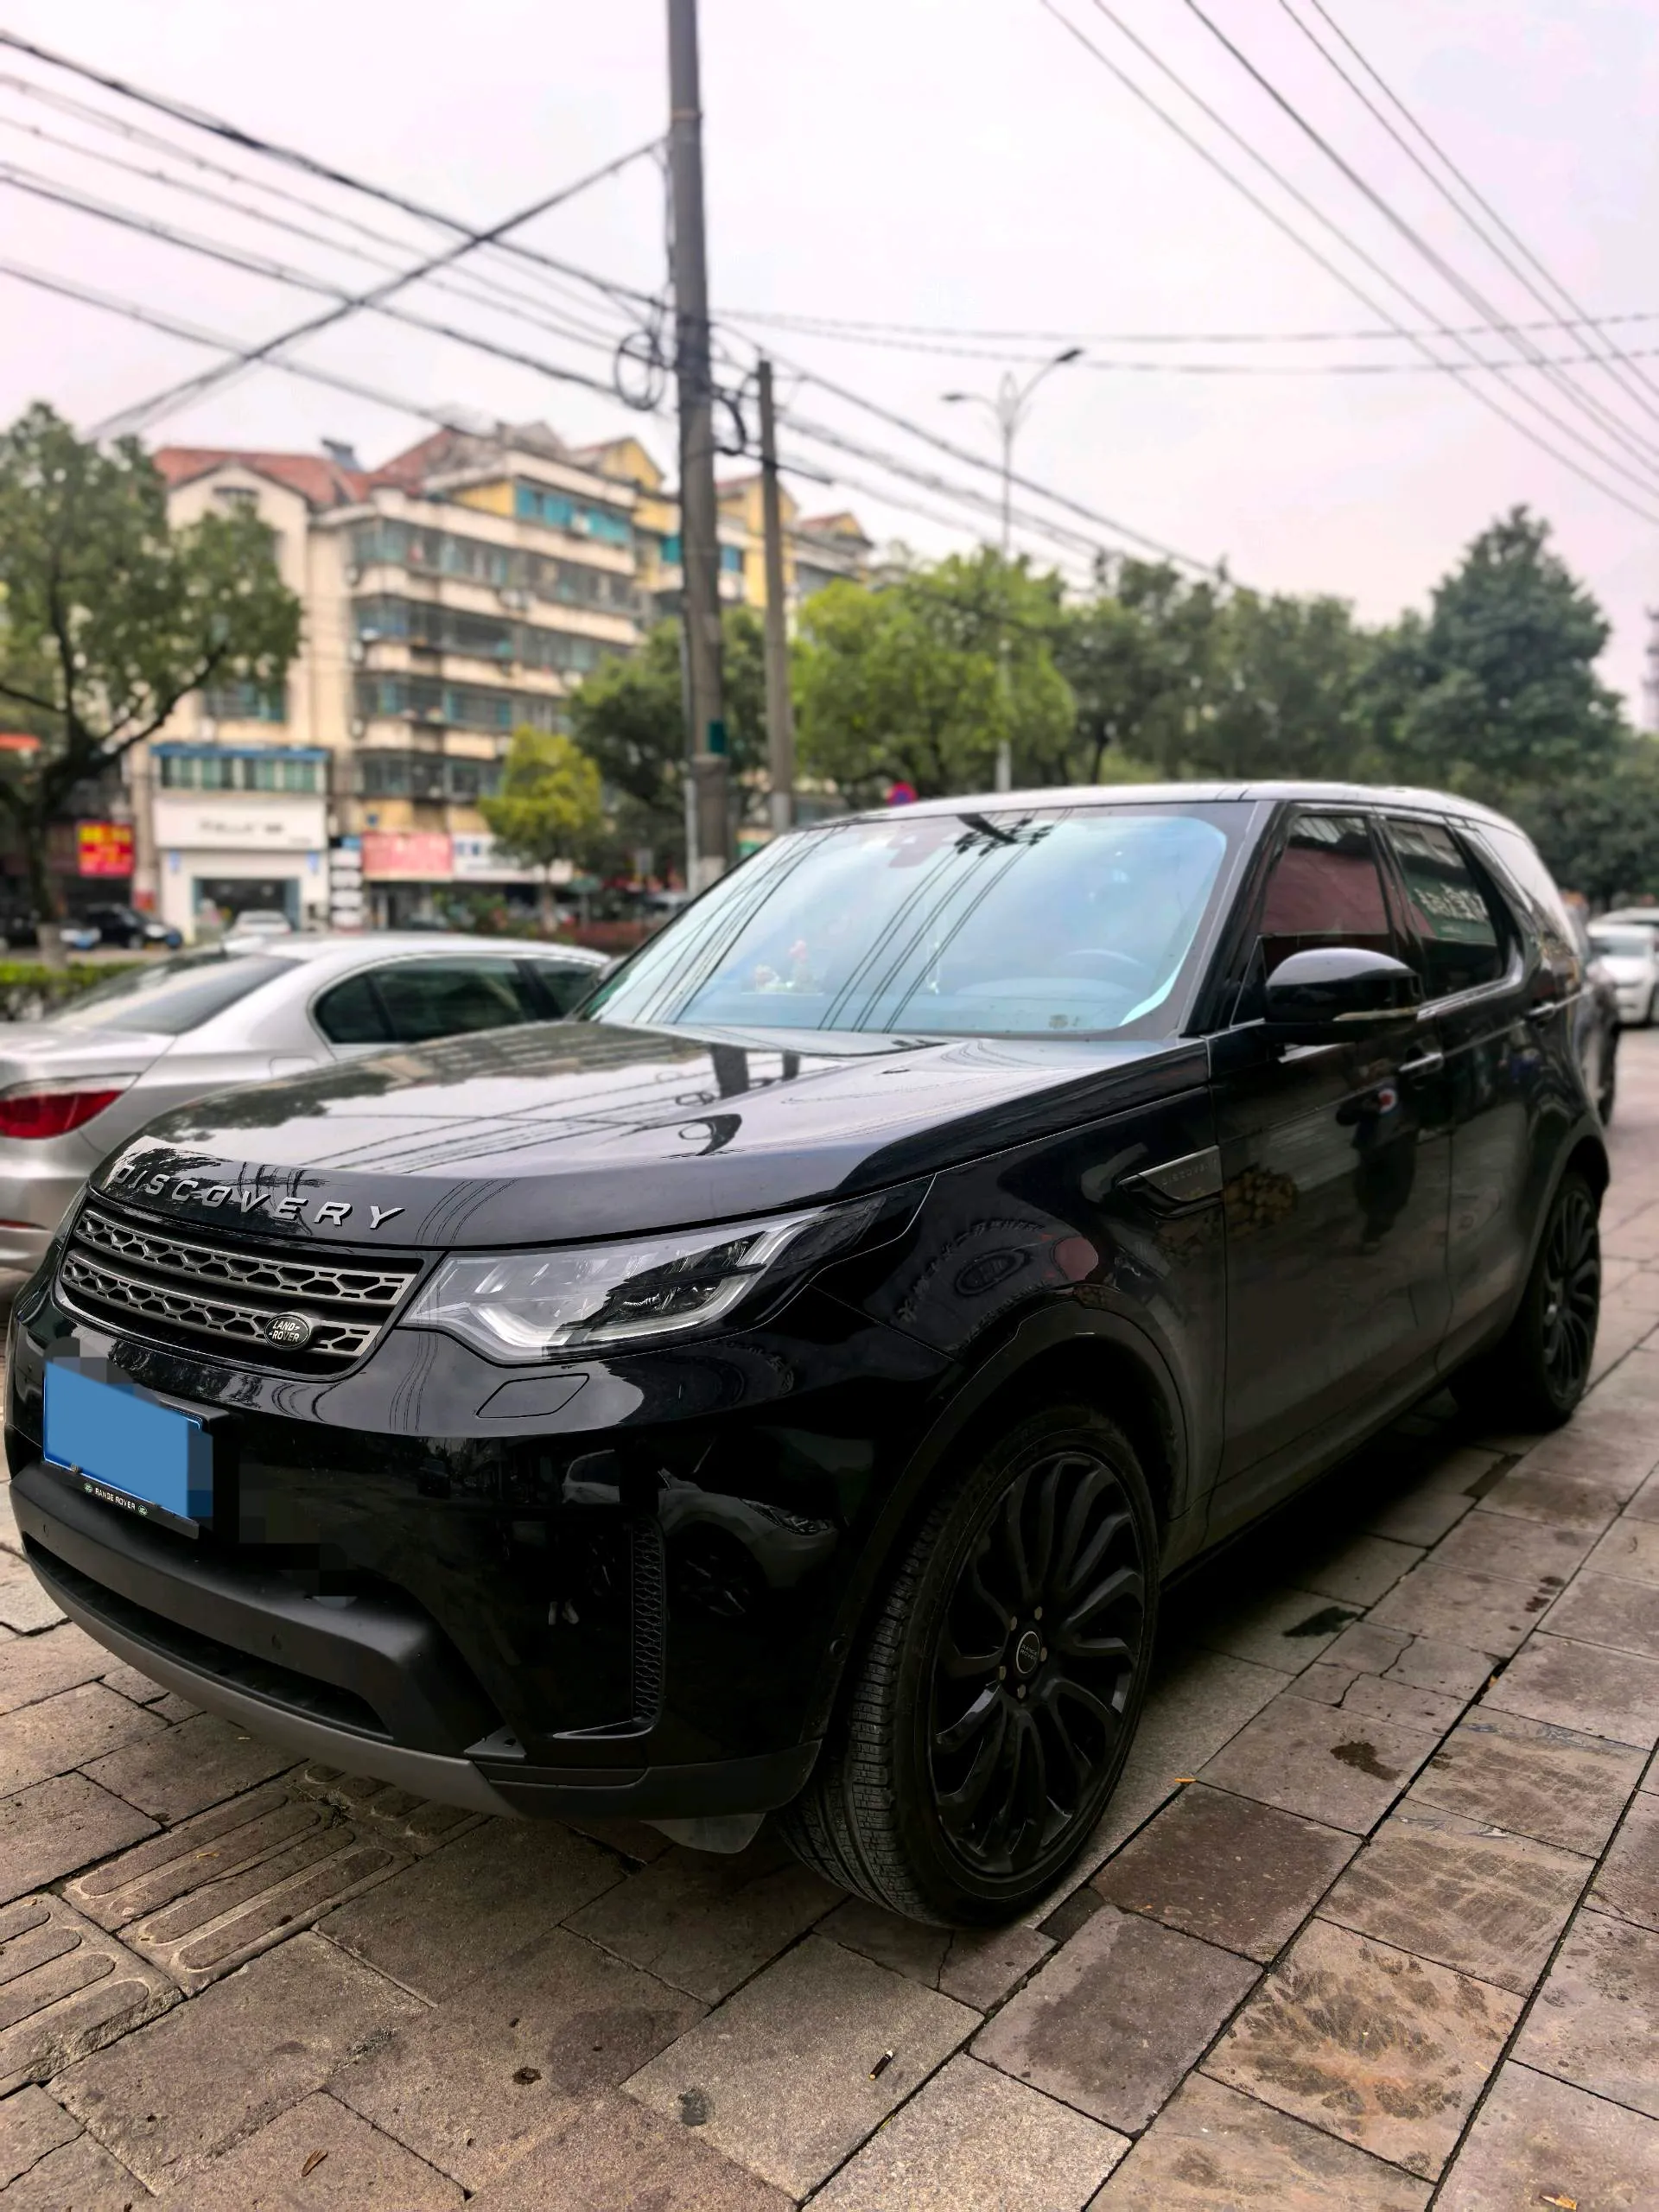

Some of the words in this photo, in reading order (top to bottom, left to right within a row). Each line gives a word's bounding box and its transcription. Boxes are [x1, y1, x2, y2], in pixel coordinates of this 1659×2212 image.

[114, 1166, 406, 1230] DISCOVERY
[272, 1319, 296, 1332] LAND
[272, 1330, 300, 1342] ROVER
[95, 1487, 114, 1502] RANGE
[115, 1496, 136, 1510] ROVER
